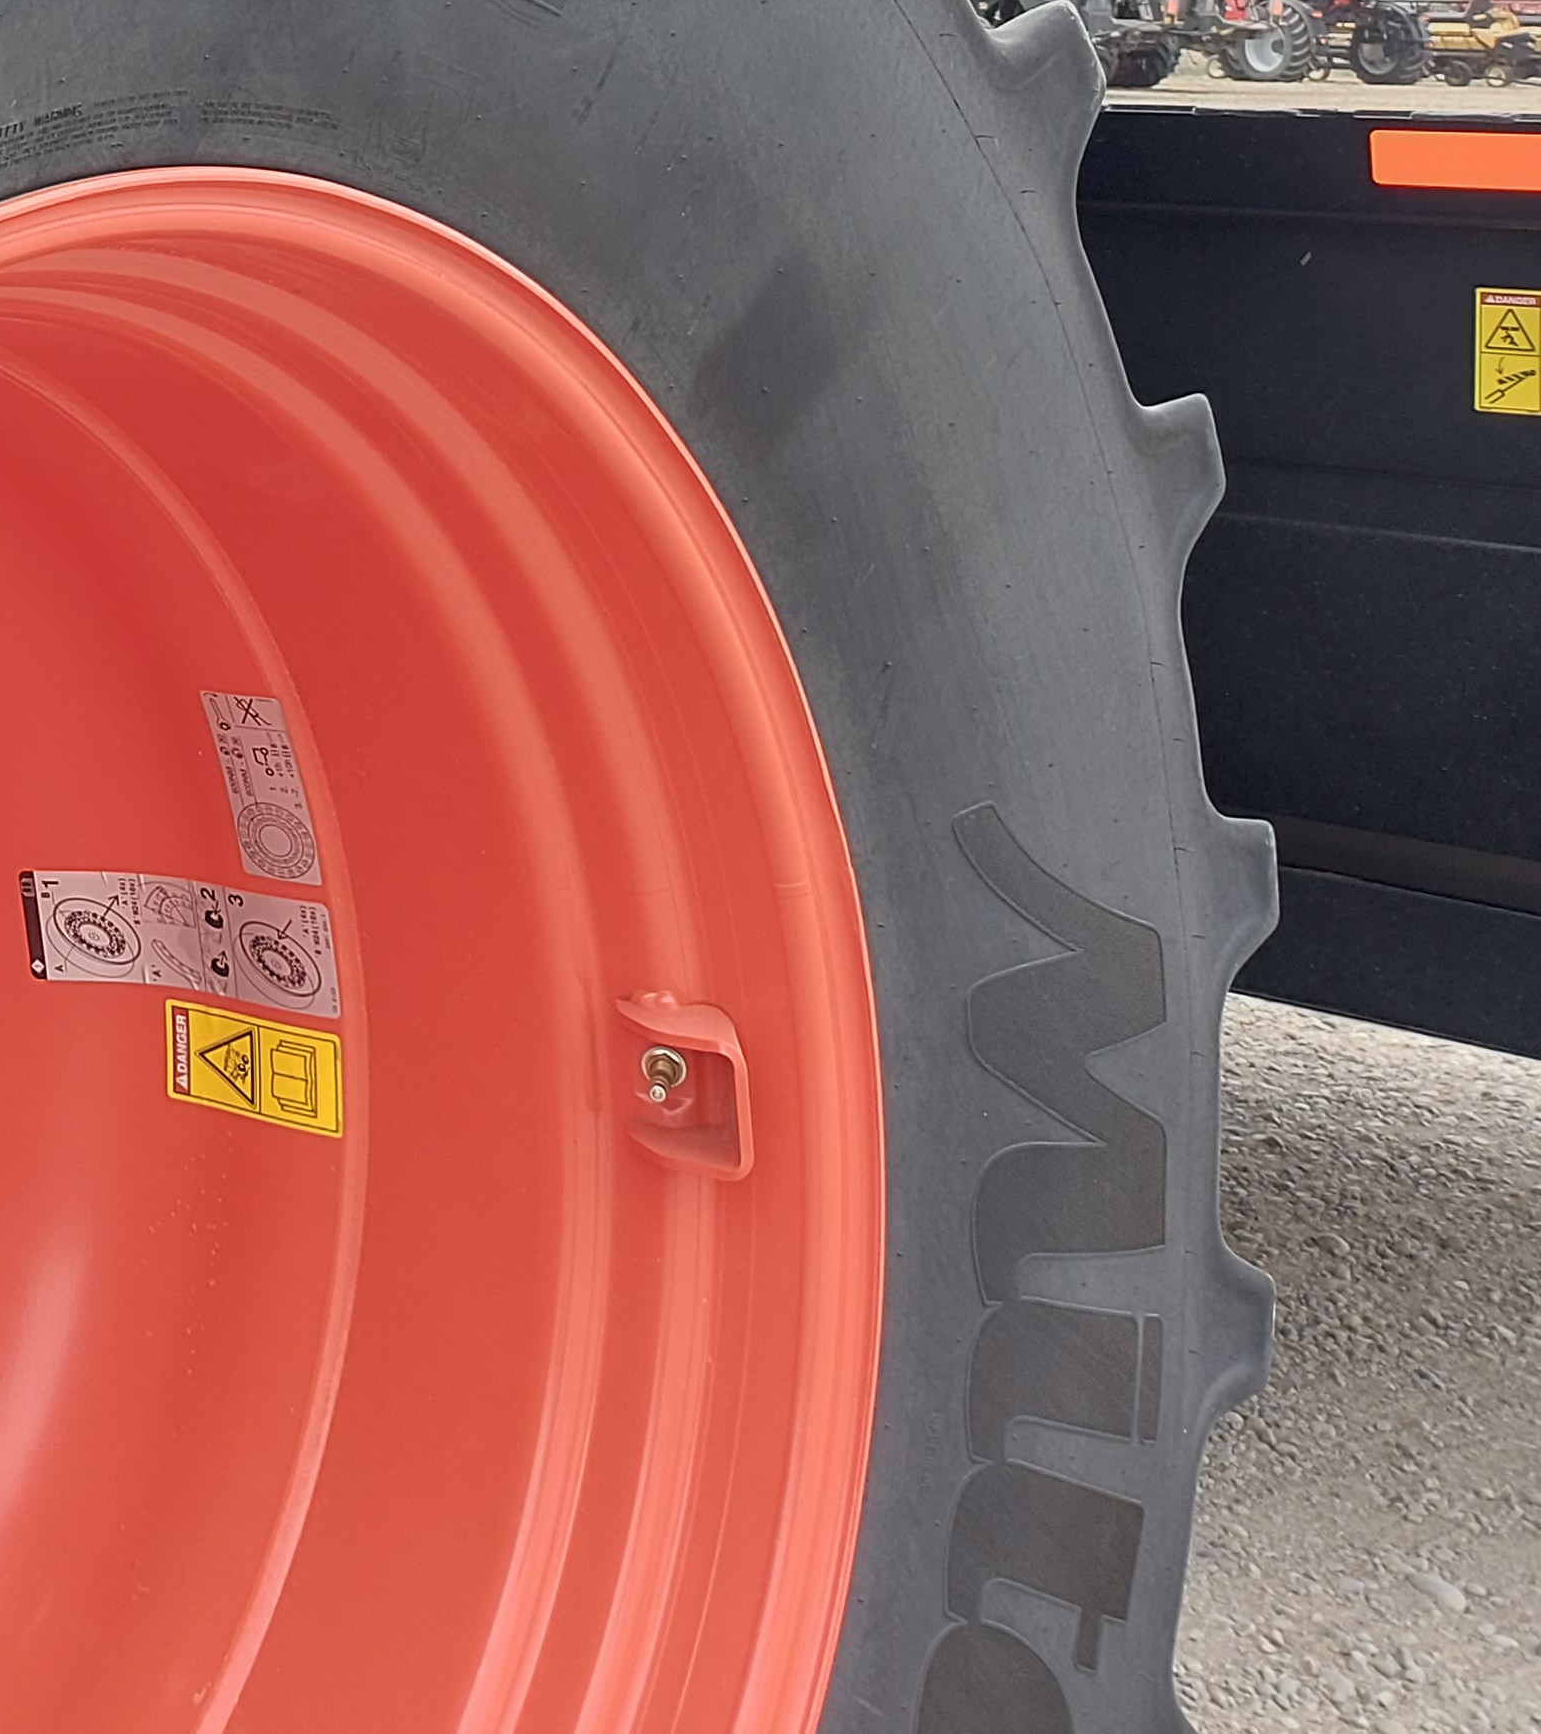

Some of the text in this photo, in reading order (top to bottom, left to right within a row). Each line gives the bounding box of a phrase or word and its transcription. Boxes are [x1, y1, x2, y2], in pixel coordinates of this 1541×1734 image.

[41, 879, 59, 890] 1
[200, 887, 217, 902] 2
[227, 893, 245, 908] 3
[54, 964, 65, 973] A
[175, 1014, 189, 1072] DANGER
